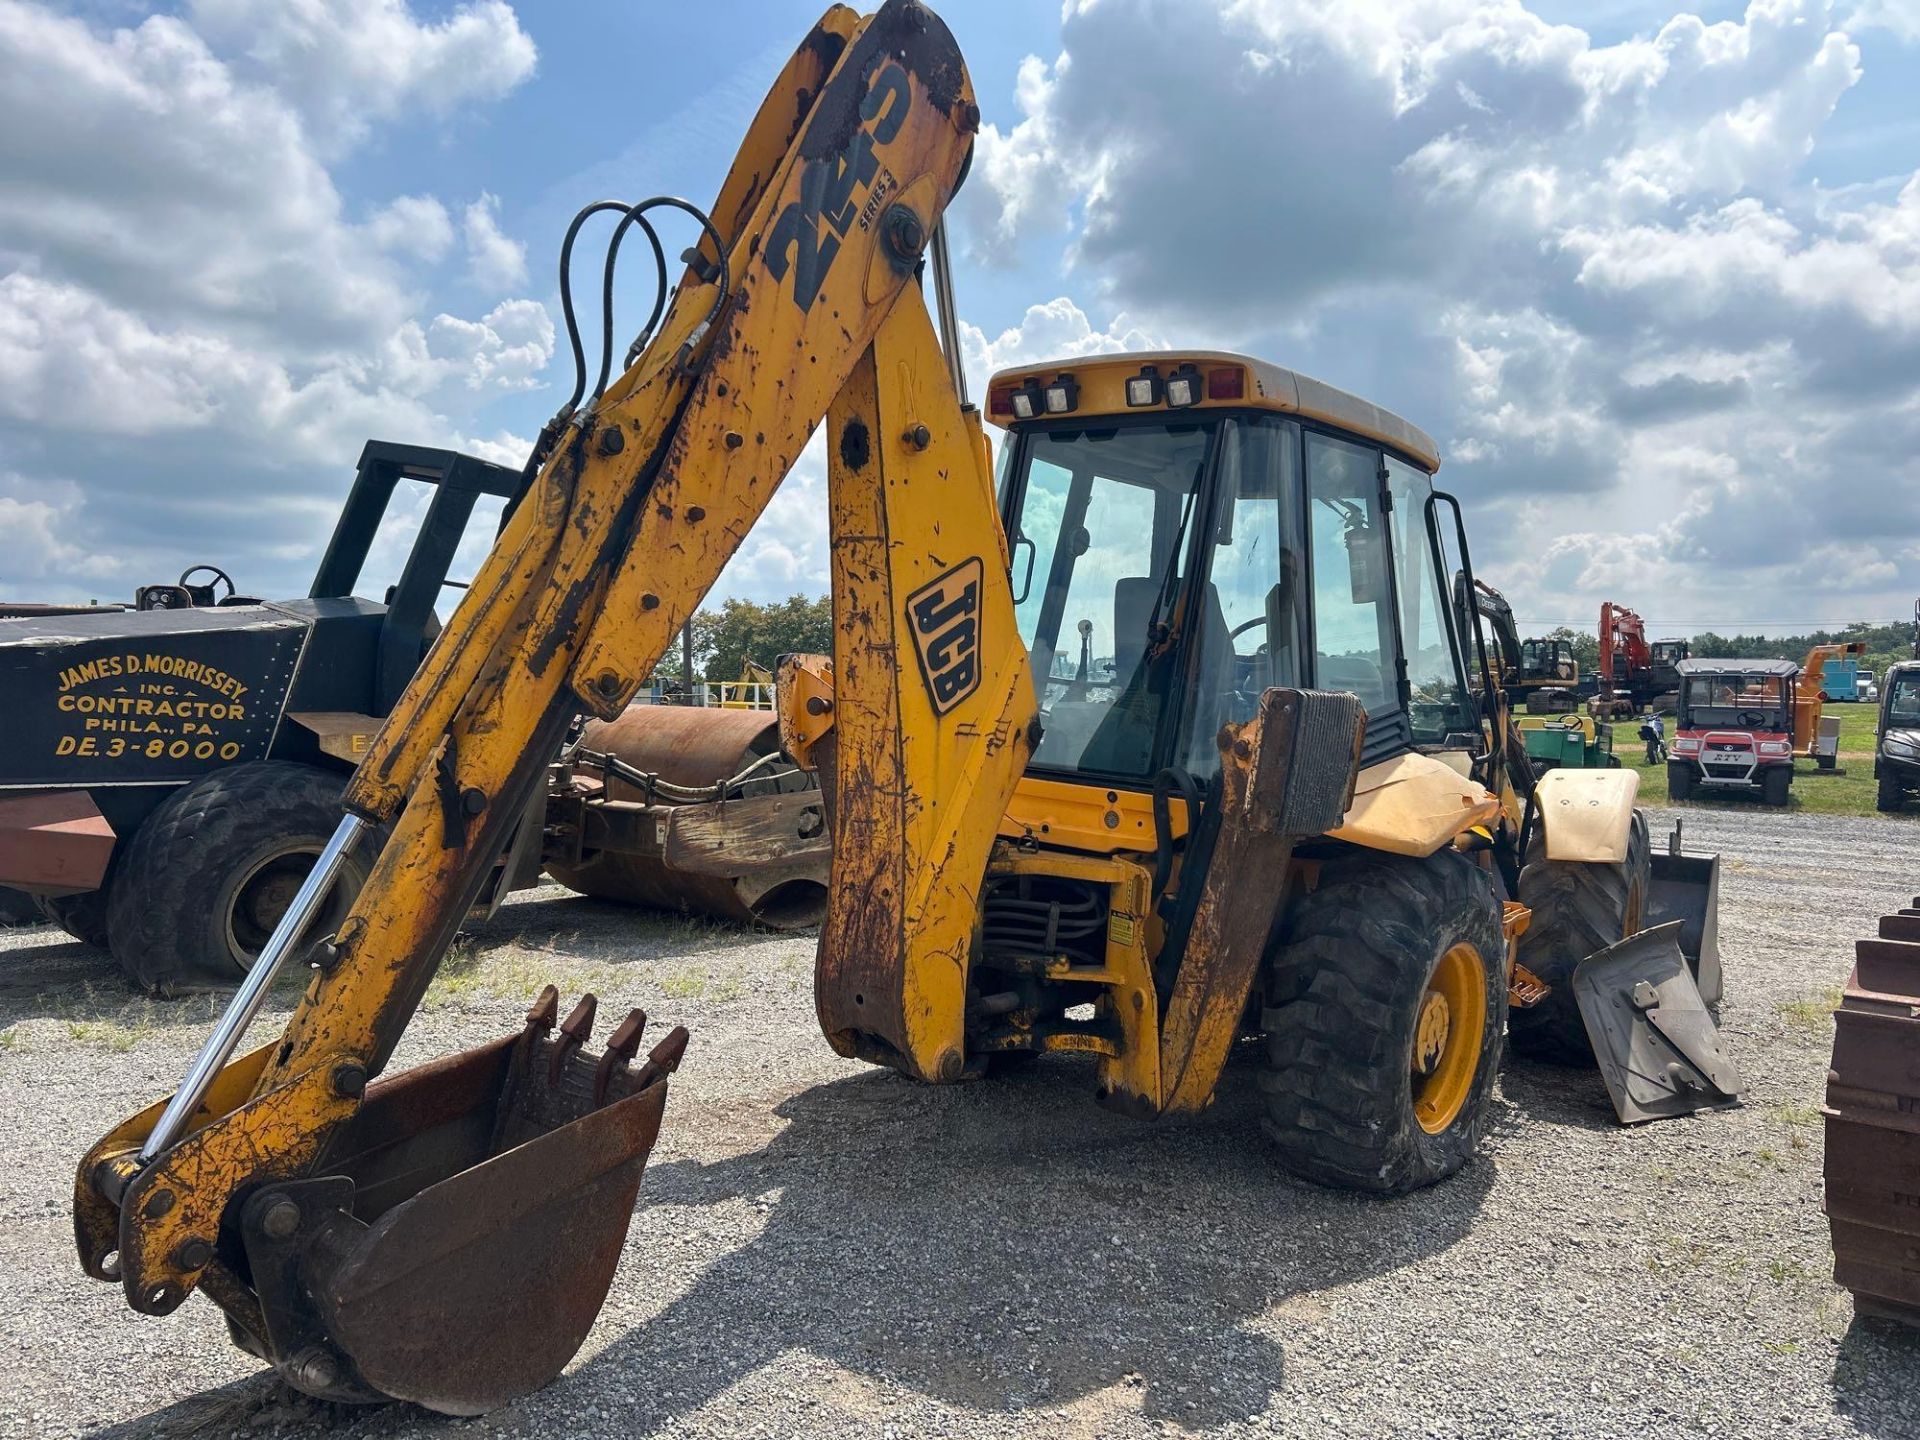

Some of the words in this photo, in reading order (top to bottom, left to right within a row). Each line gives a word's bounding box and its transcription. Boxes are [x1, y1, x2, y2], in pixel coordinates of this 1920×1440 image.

[859, 185, 886, 232] SERIES
[914, 579, 977, 704] JCB
[58, 656, 123, 691] JAMES
[140, 684, 179, 696] INC.
[58, 695, 246, 720] CONTRACTOR
[182, 722, 220, 736] PA.
[1712, 753, 1742, 762] RTV
